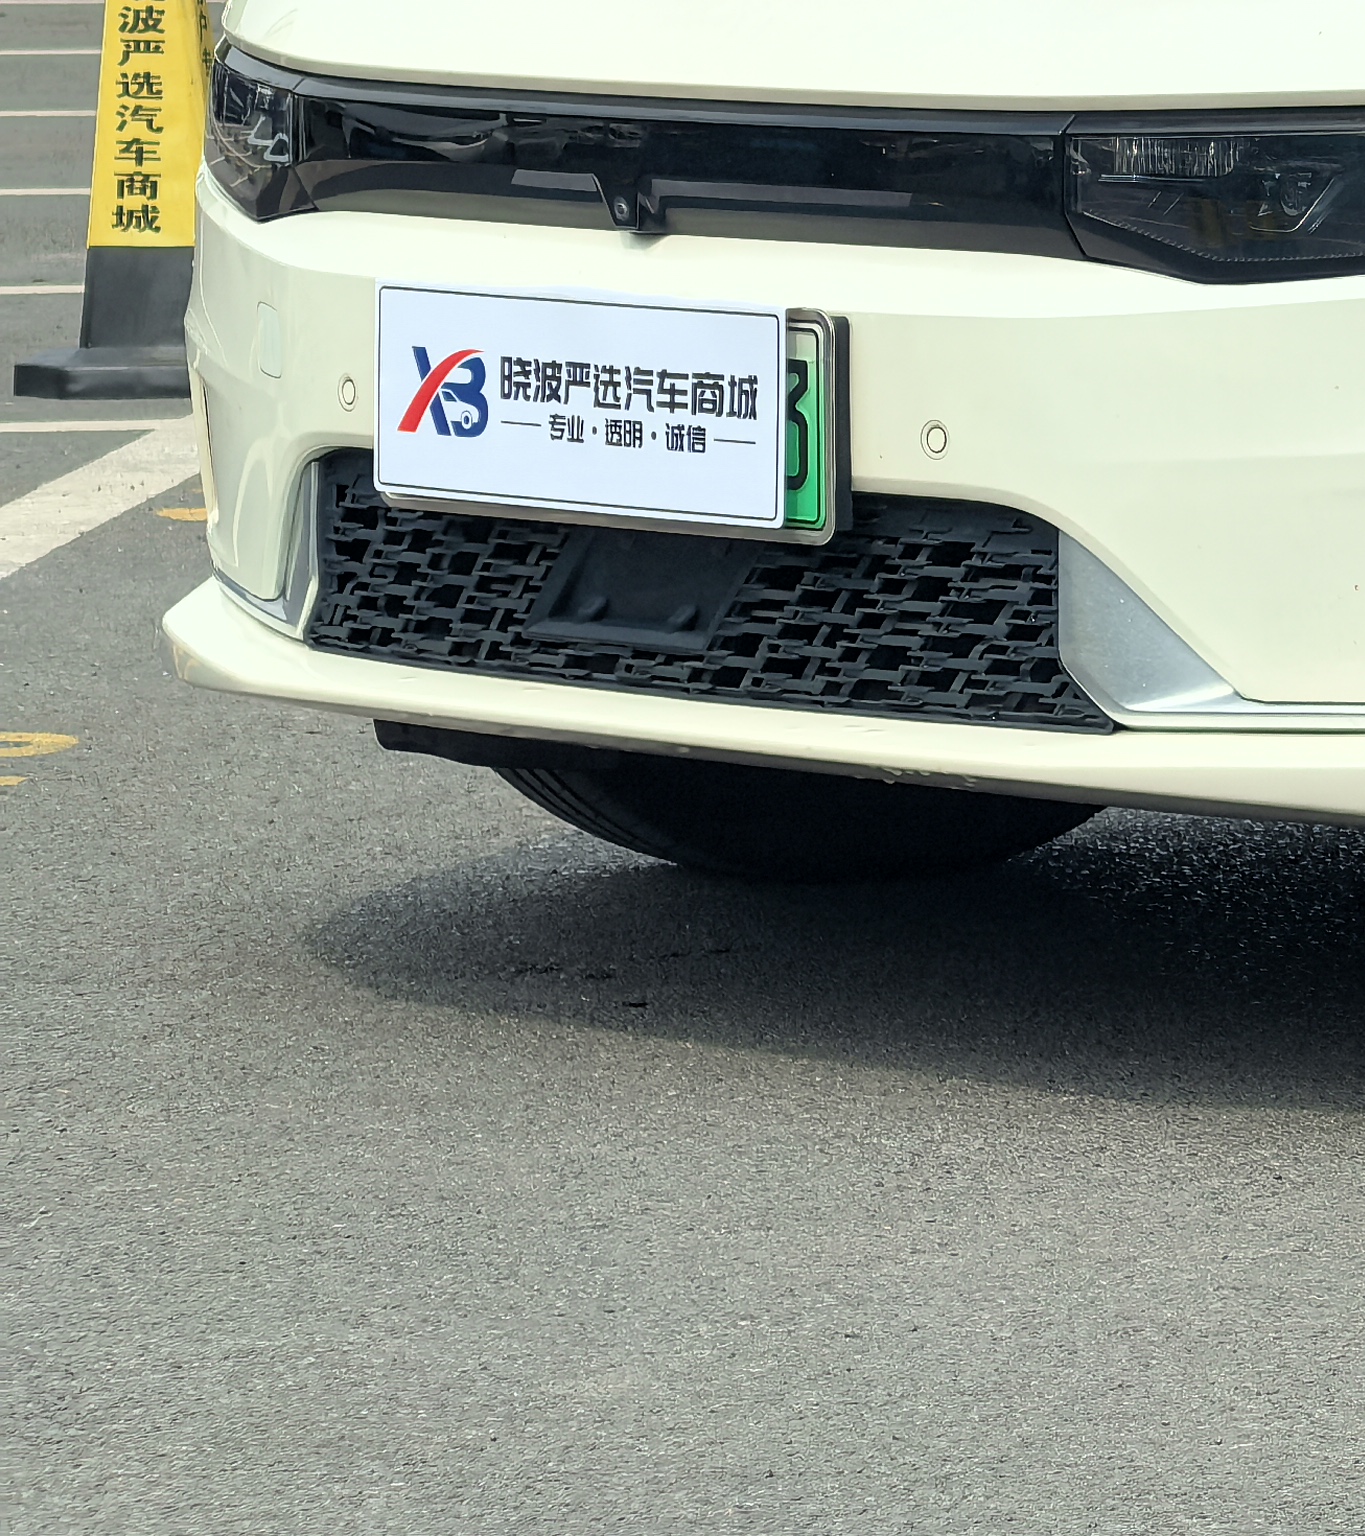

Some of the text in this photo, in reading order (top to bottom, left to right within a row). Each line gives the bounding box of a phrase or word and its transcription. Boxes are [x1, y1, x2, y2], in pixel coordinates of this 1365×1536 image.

[500, 356, 758, 420] 晓波严选汽车商城
